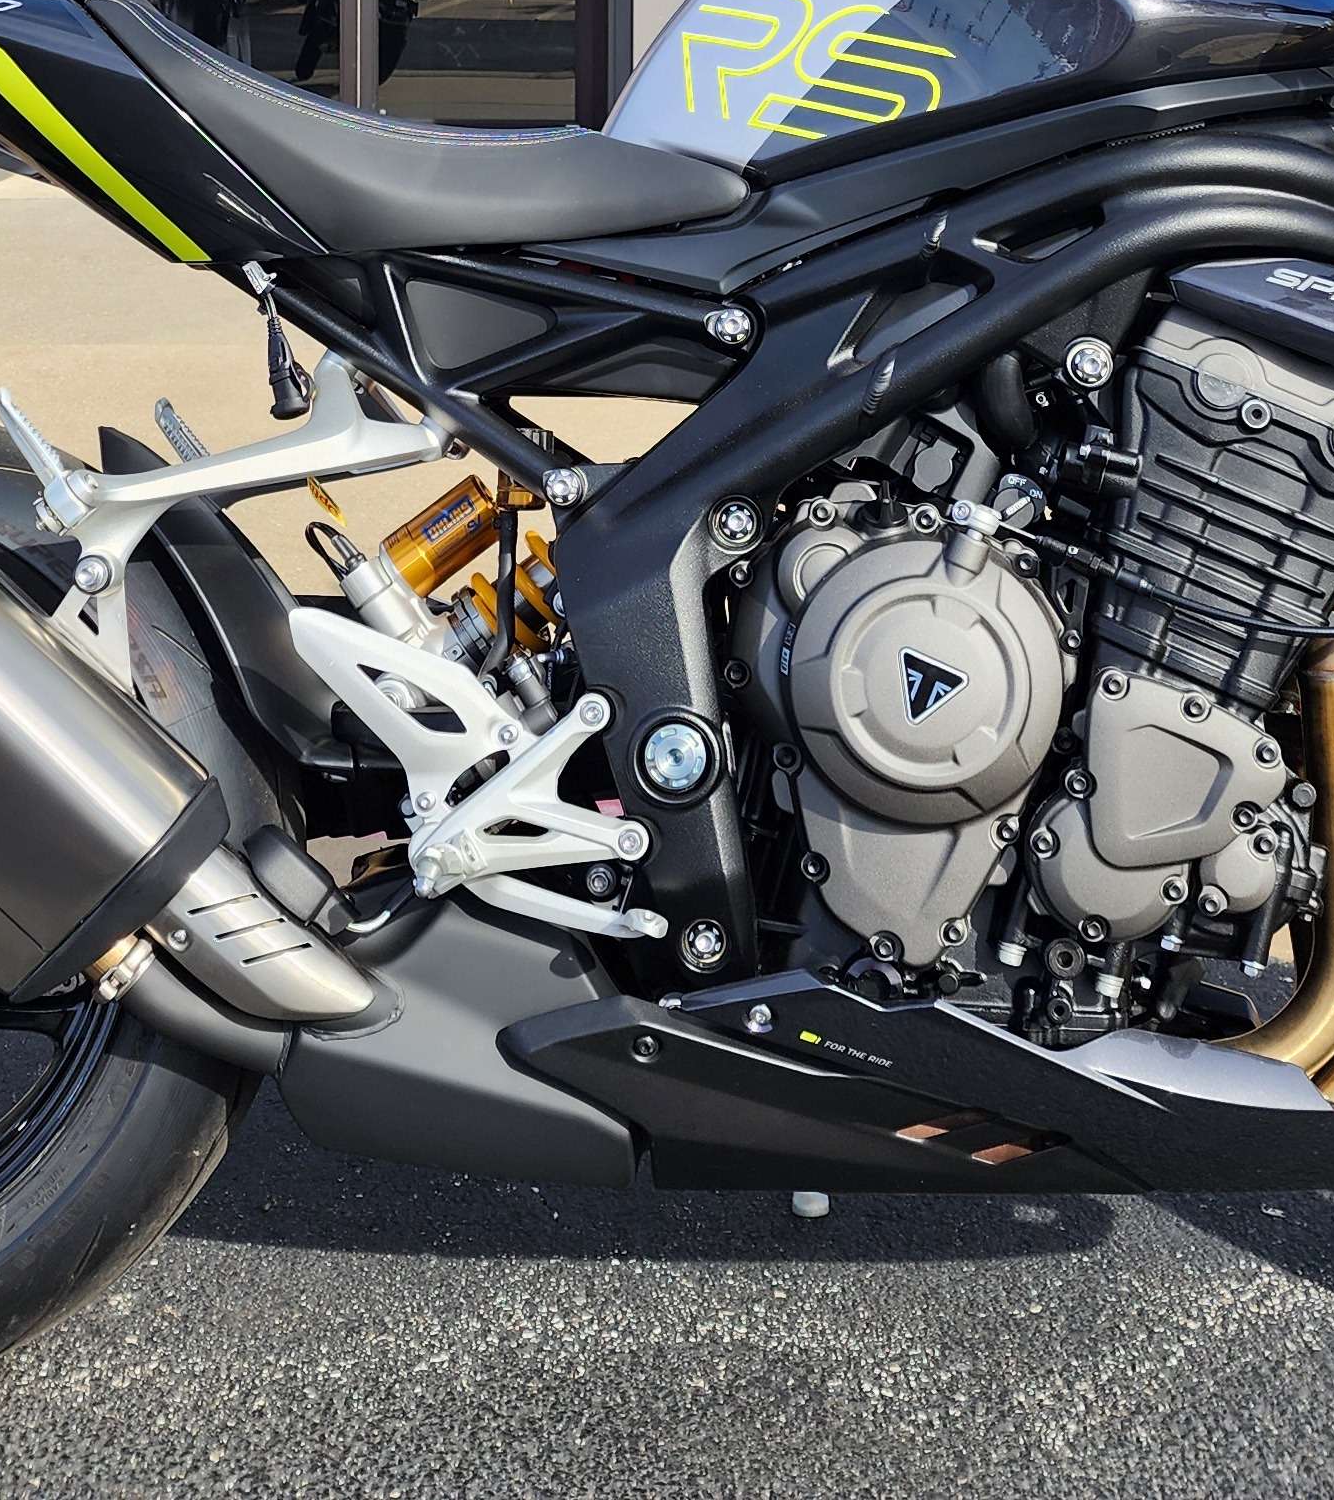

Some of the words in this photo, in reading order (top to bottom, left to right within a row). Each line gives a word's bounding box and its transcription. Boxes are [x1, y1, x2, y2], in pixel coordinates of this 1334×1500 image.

[1008, 475, 1027, 487] OFF
[1029, 488, 1044, 500] ON
[823, 1040, 847, 1053] FOR
[847, 1047, 868, 1060] THE
[867, 1055, 894, 1069] RIDE
